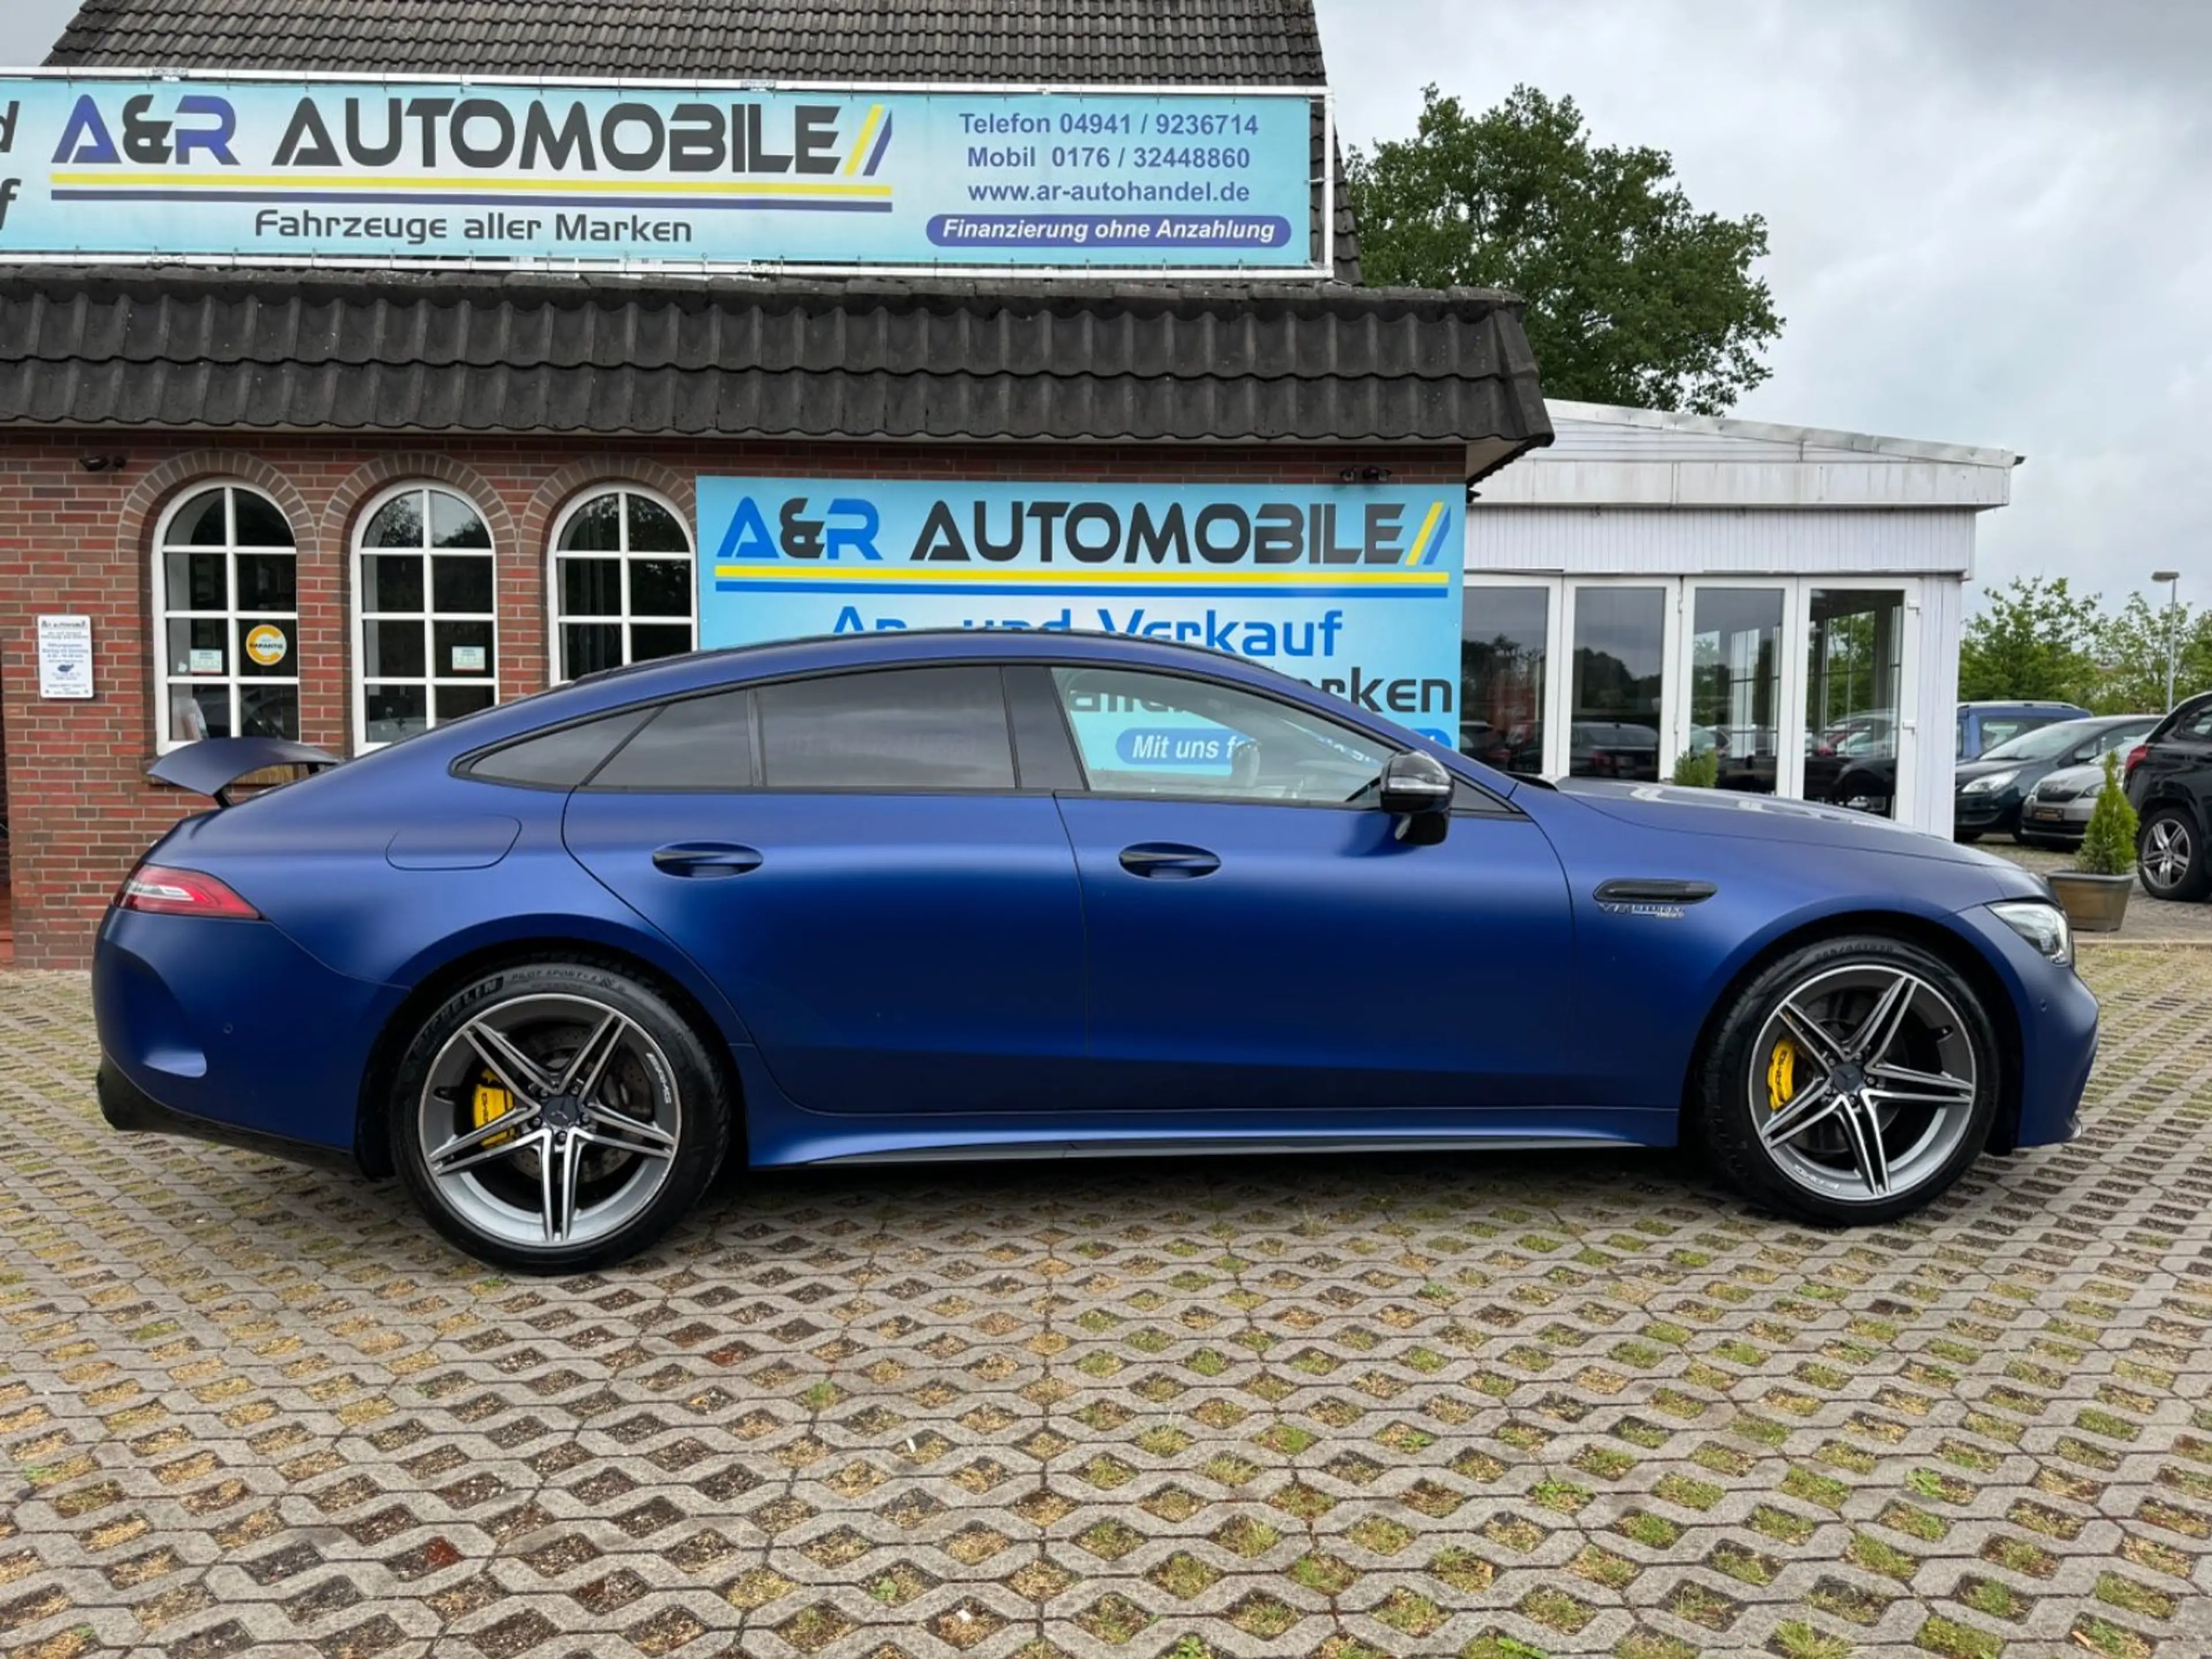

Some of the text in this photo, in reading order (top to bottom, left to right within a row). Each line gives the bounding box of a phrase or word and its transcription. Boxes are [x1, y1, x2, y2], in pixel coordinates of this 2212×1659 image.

[51, 94, 240, 165] A&R
[959, 113, 1259, 135] Telefon 04941 / 9236714
[968, 147, 1251, 168] Mobil 0176 / 32448860
[968, 182, 1250, 202] www.ar-autohandel.de
[256, 209, 692, 245] Fahrzeuge aller Marken
[942, 219, 1275, 242] Finanzierung ohne Anzahlung
[717, 496, 883, 560] A&R
[1132, 735, 1169, 759] Mit
[1175, 738, 1219, 759] uns
